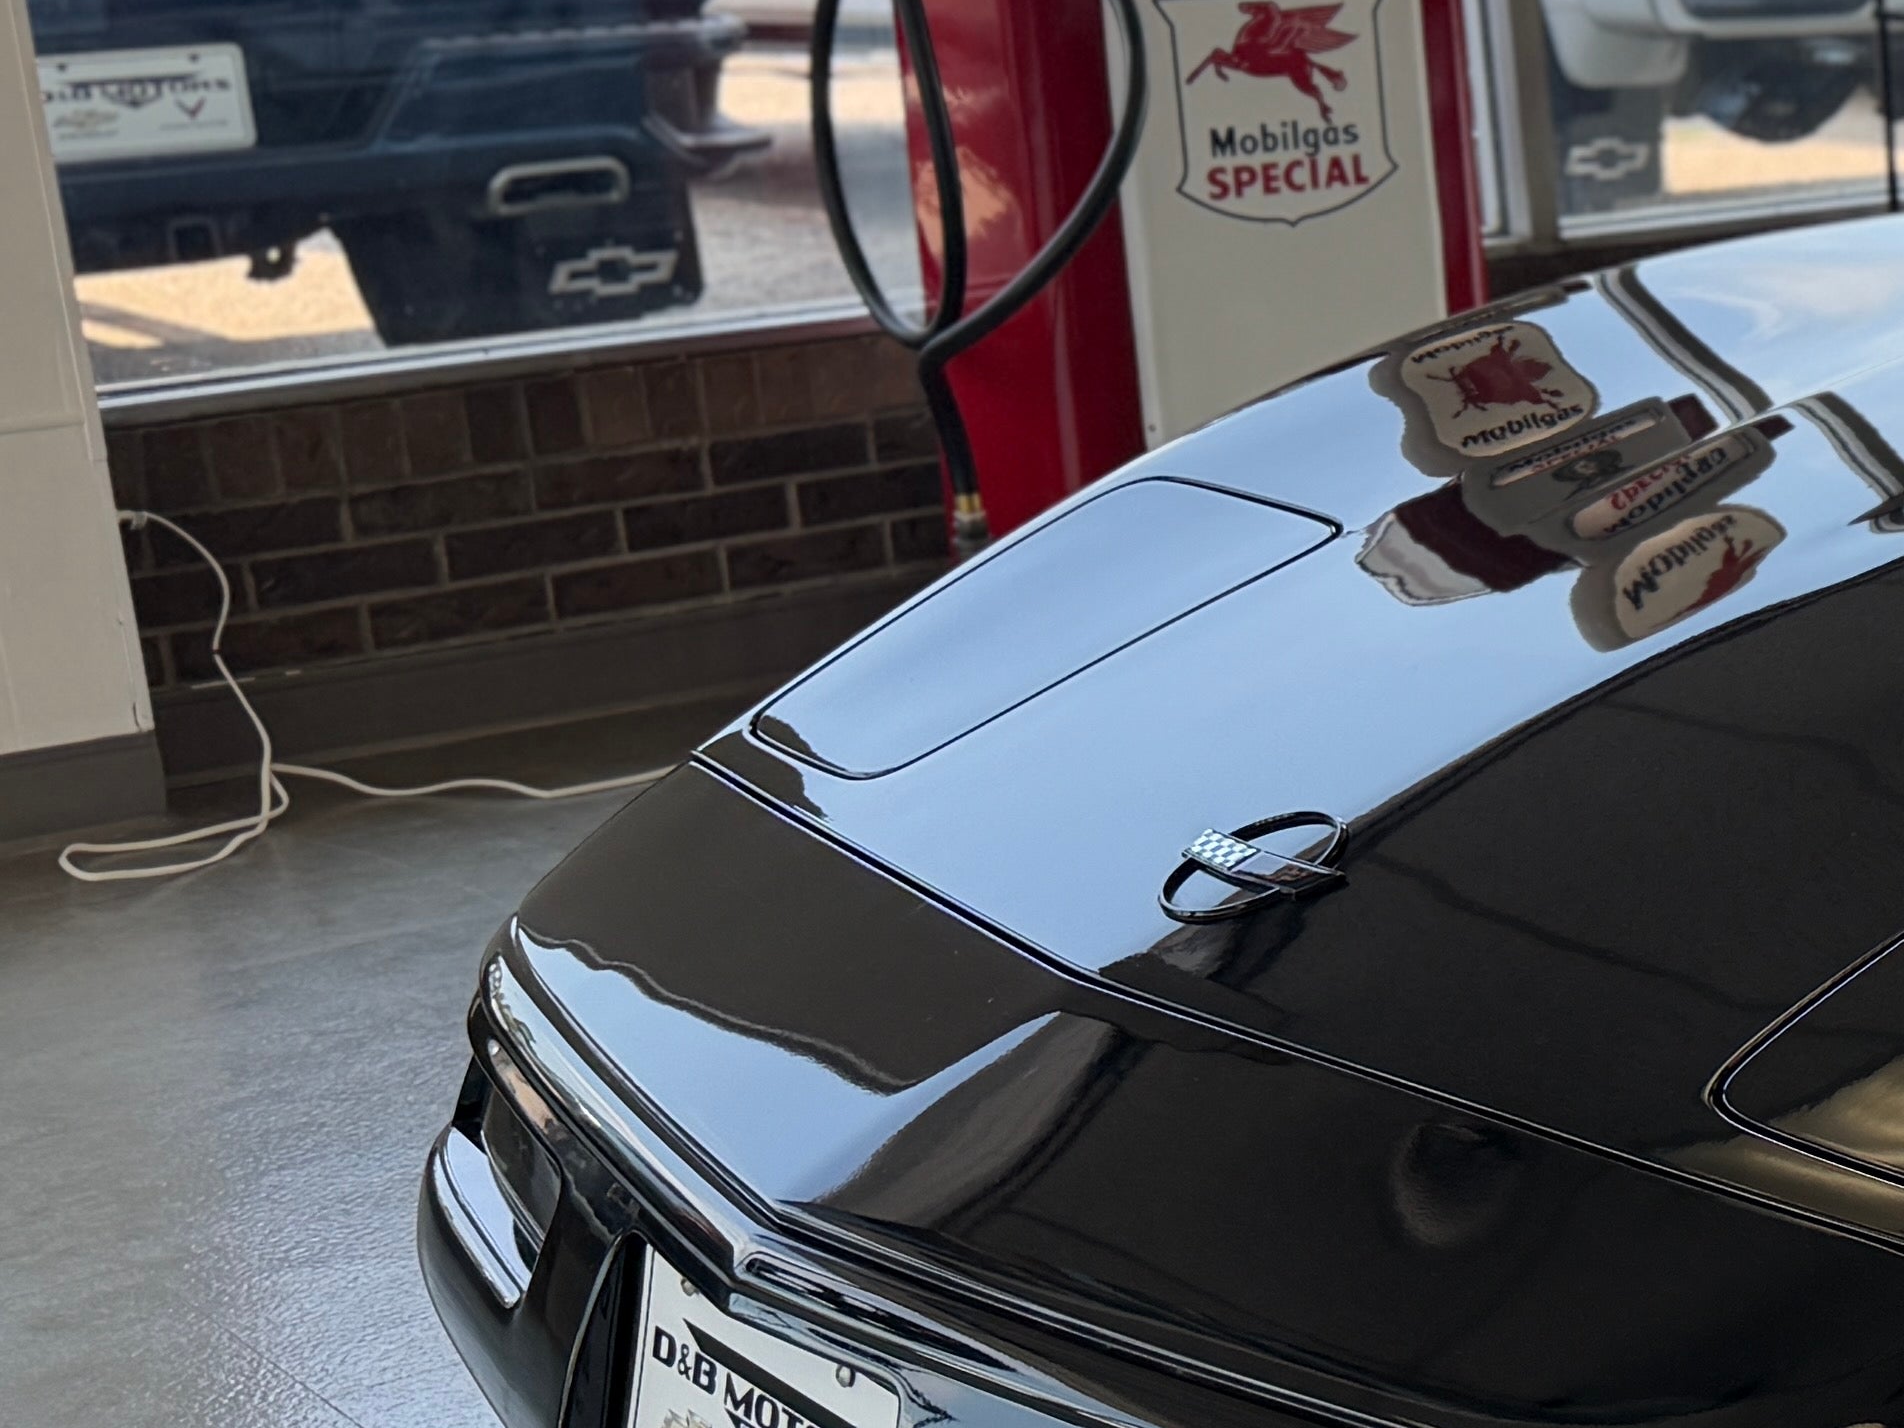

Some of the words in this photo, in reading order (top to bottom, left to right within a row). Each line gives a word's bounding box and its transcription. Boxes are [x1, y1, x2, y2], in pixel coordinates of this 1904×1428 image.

[1209, 121, 1359, 158] Mobilgas
[1207, 154, 1370, 201] SPECIAL
[652, 1326, 717, 1396] D&B
